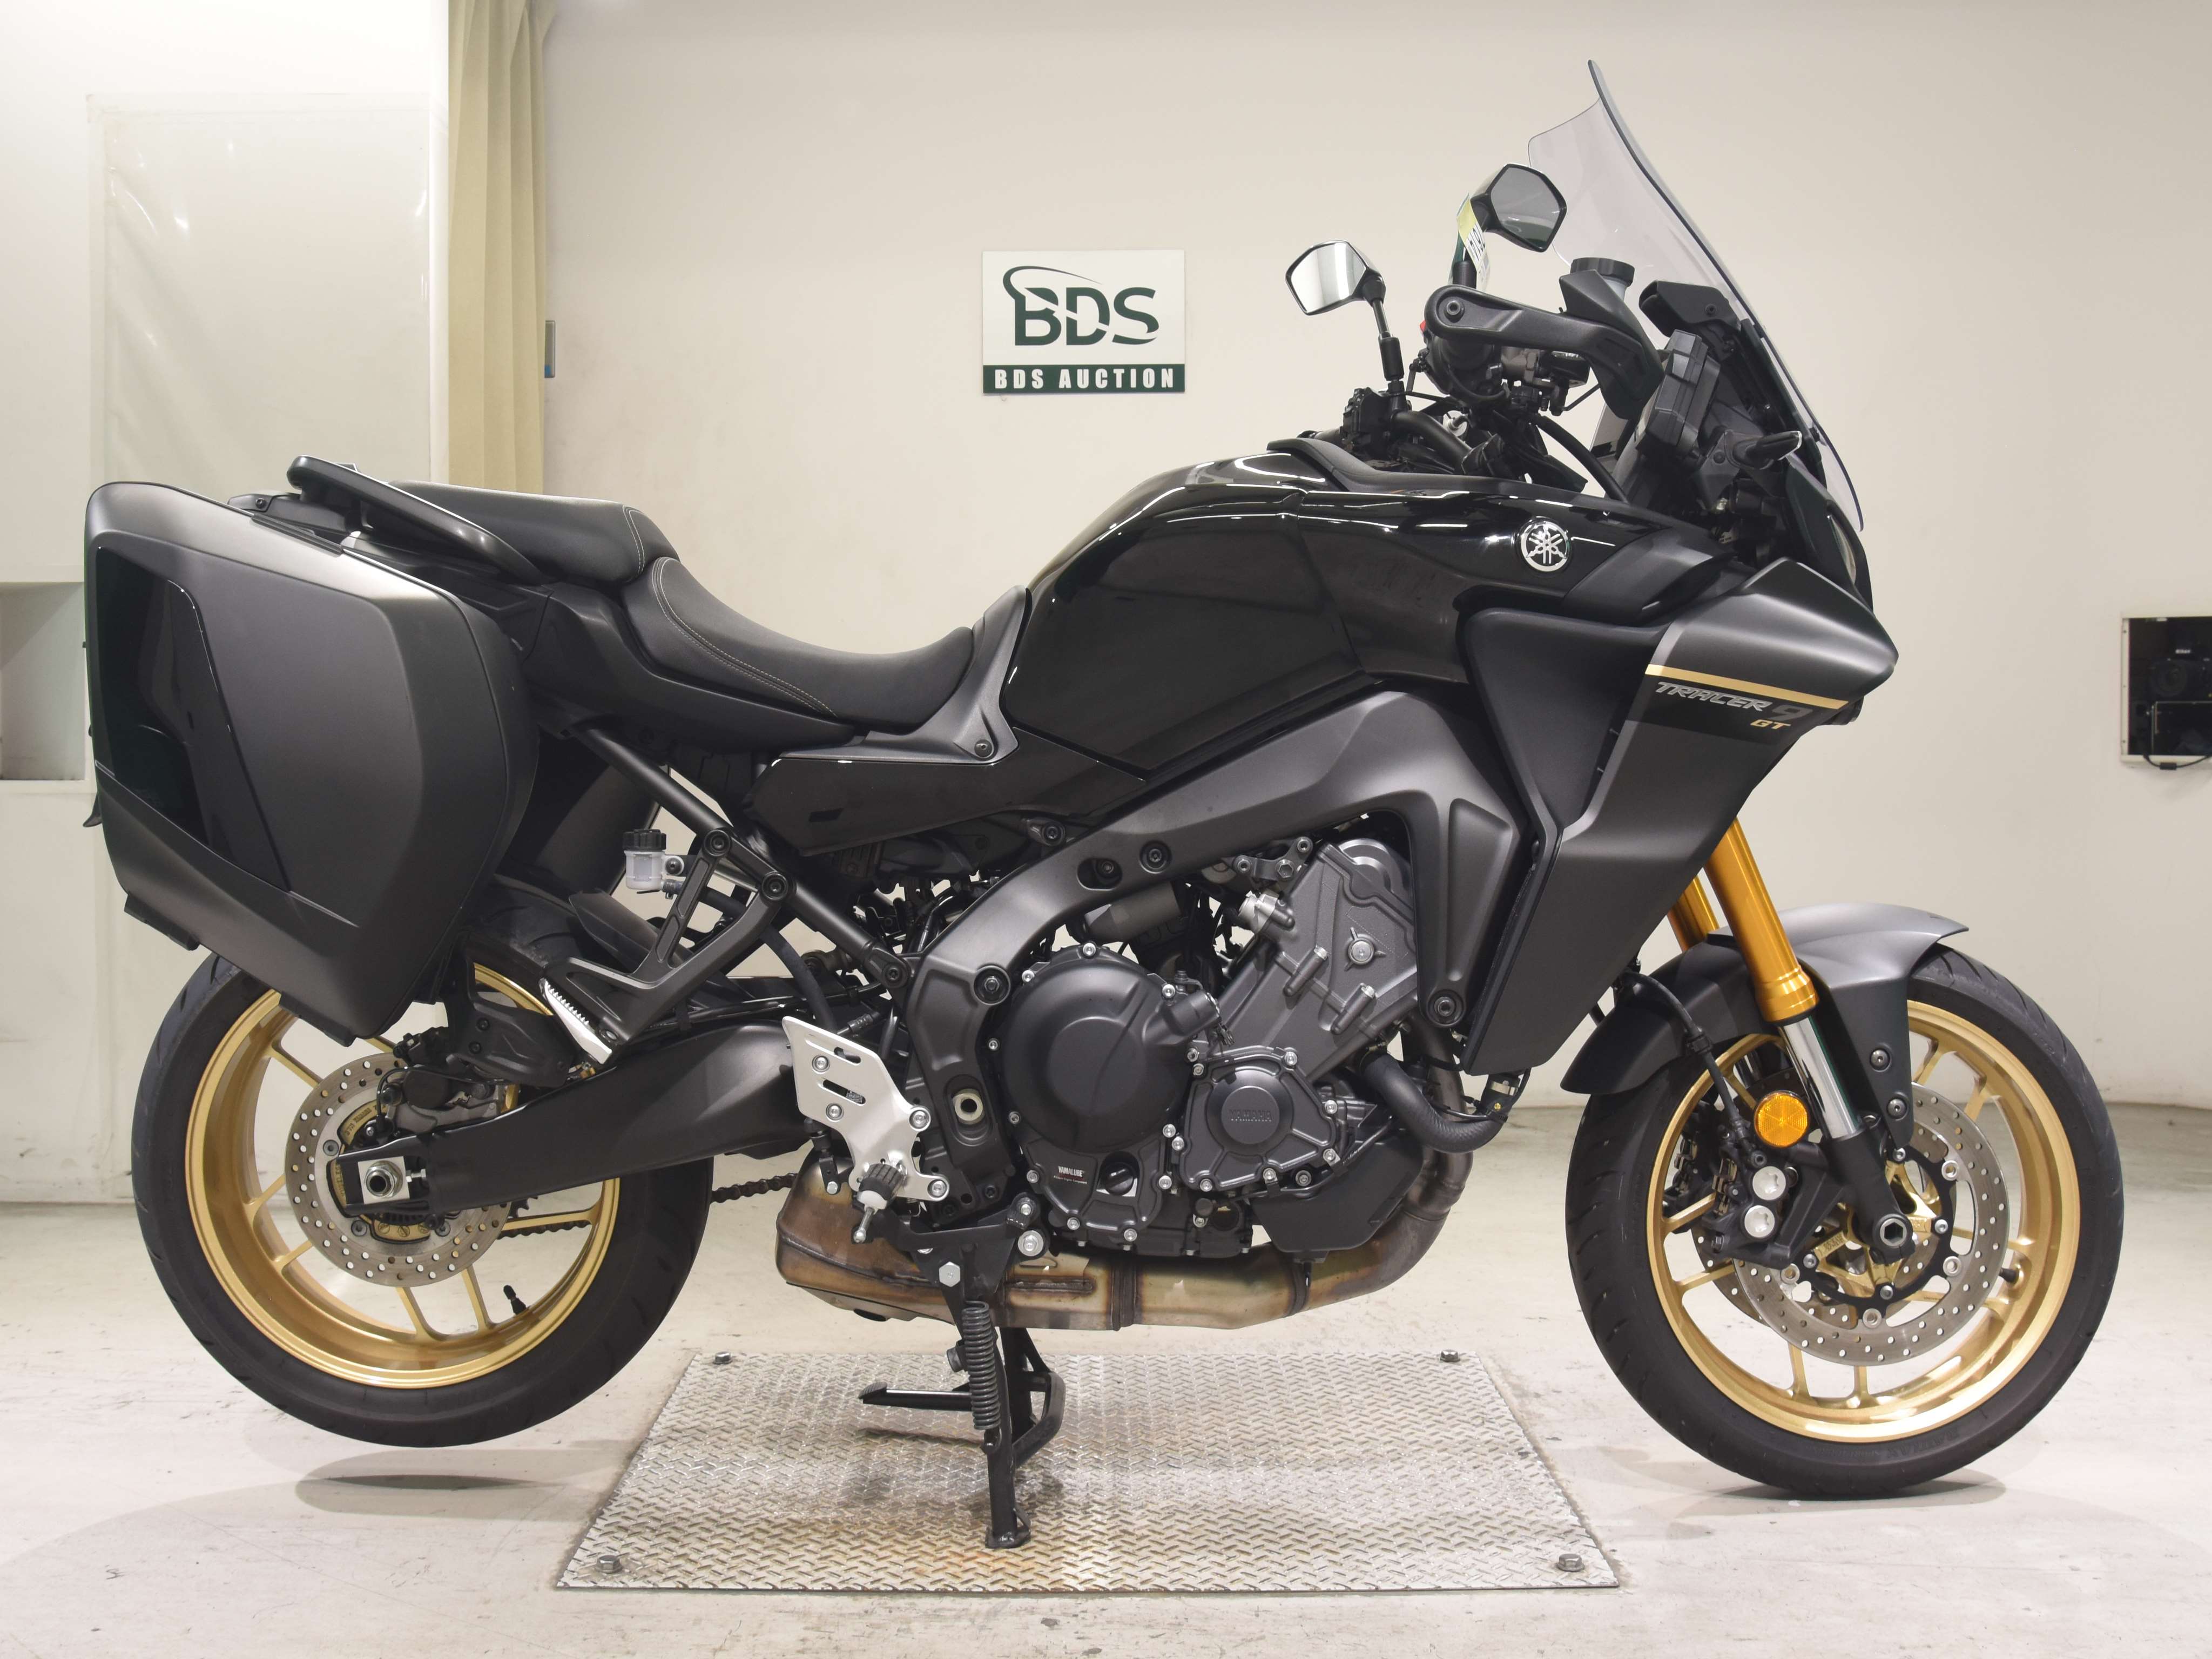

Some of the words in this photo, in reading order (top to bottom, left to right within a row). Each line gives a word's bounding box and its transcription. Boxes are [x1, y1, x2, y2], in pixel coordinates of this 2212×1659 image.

[1003, 265, 1159, 346] BDS
[994, 369, 1044, 389] BDS
[1058, 368, 1174, 389] AUCTION
[1655, 681, 1773, 712] TRACER
[1769, 704, 1813, 721] 9
[1750, 719, 1791, 730] GT
[1230, 1109, 1273, 1122] YAMAHA
[1058, 1165, 1083, 1177] YAMALUBE
